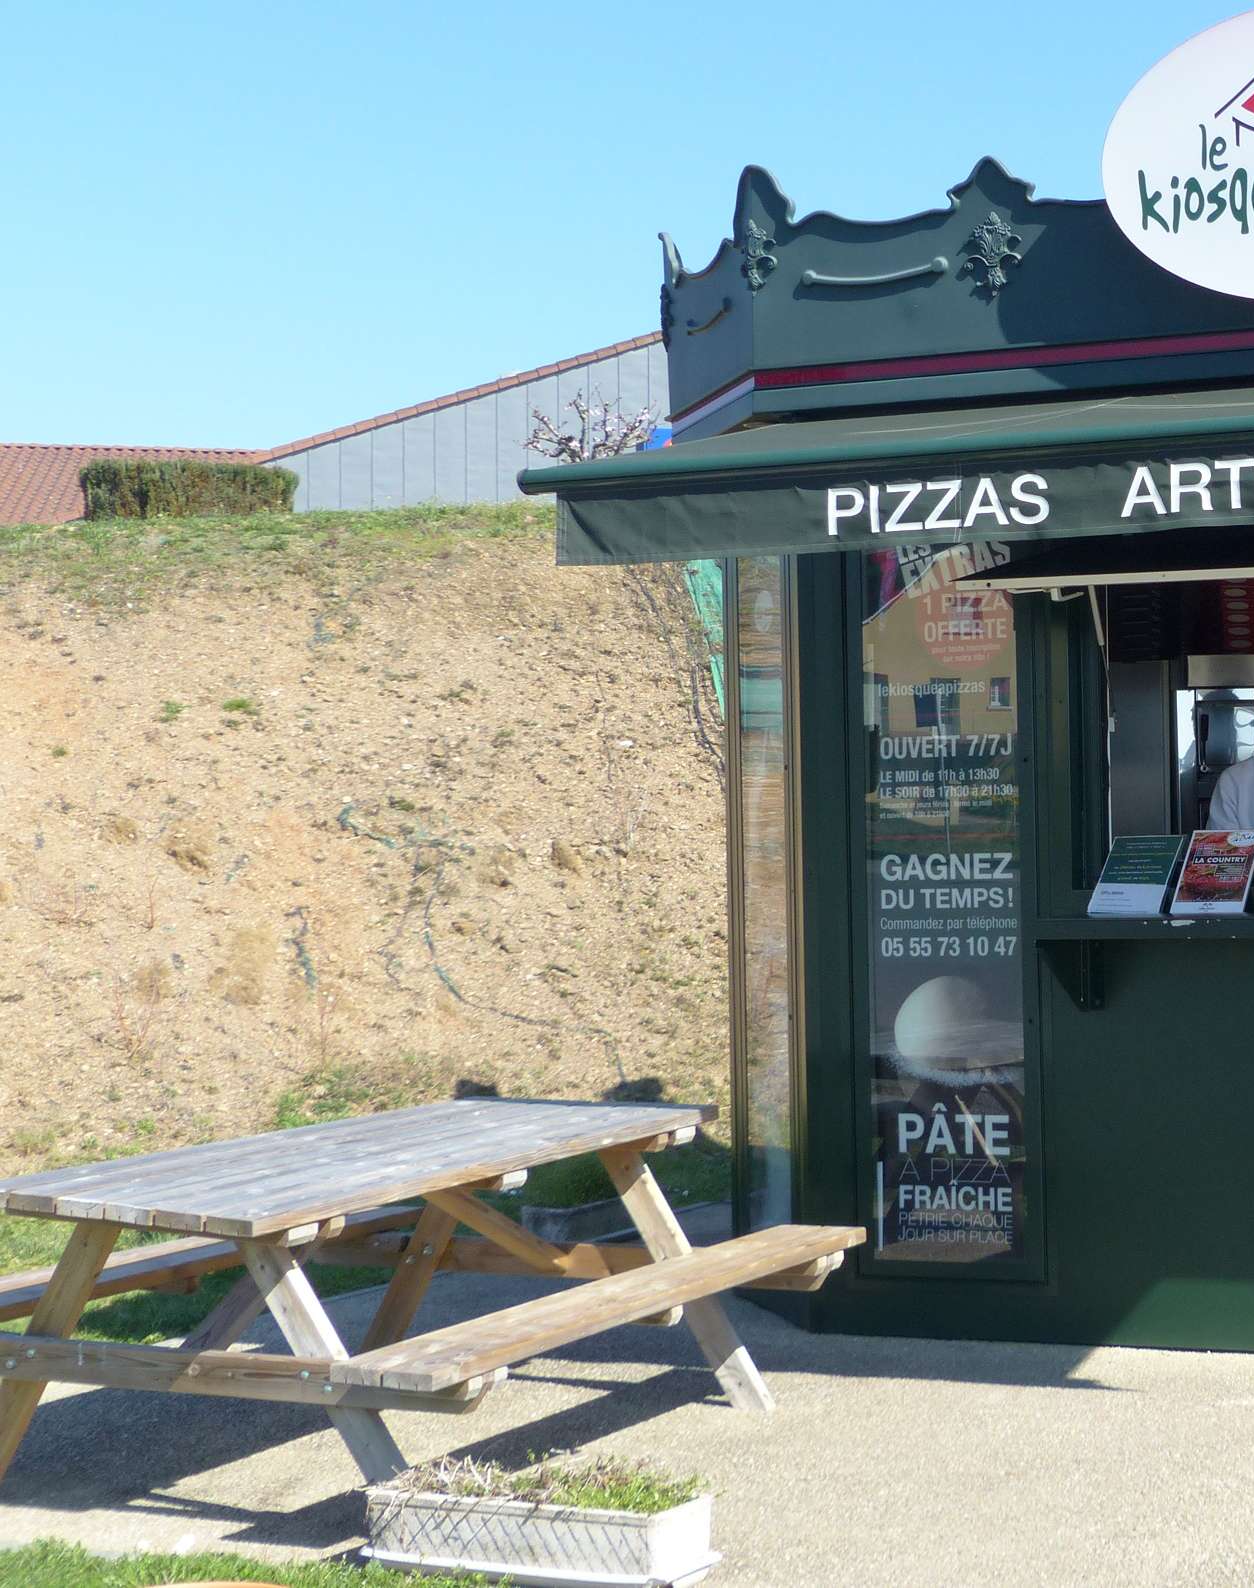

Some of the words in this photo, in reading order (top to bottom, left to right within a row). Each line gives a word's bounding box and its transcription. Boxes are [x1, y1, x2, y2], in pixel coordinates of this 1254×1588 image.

[1198, 123, 1228, 171] le
[826, 473, 1050, 536] PIZZAS
[924, 617, 1008, 643] OFFERTE
[880, 734, 960, 760] OUVERT
[966, 733, 1012, 757] 7/7J
[880, 770, 893, 783] LE
[895, 769, 919, 783] MIDI
[922, 769, 934, 782] de
[958, 768, 966, 780] à
[969, 767, 1000, 780] 13h30
[880, 786, 893, 799] LE
[895, 786, 919, 799] SOIR
[922, 785, 935, 798] de
[880, 852, 1013, 881] GAGNEZ
[1194, 856, 1205, 864] LA
[1206, 856, 1246, 864] COUNTRY
[881, 888, 914, 910] DU
[880, 915, 944, 930] Commandez
[946, 919, 963, 931] par
[966, 915, 1018, 931] téléphone
[881, 936, 904, 957] 05
[908, 936, 932, 957] 55
[936, 936, 960, 957] 73
[965, 936, 989, 957] 10
[993, 936, 1017, 957] 47
[897, 1102, 1010, 1156] PÂTE
[930, 1157, 1011, 1184] PIZZA
[898, 1179, 1013, 1212] FRAÎCHE
[951, 1212, 1013, 1229] CHAQUE
[897, 1226, 934, 1242] JOUR
[937, 1228, 966, 1243] SUR
[969, 1230, 1013, 1245] PLACE
